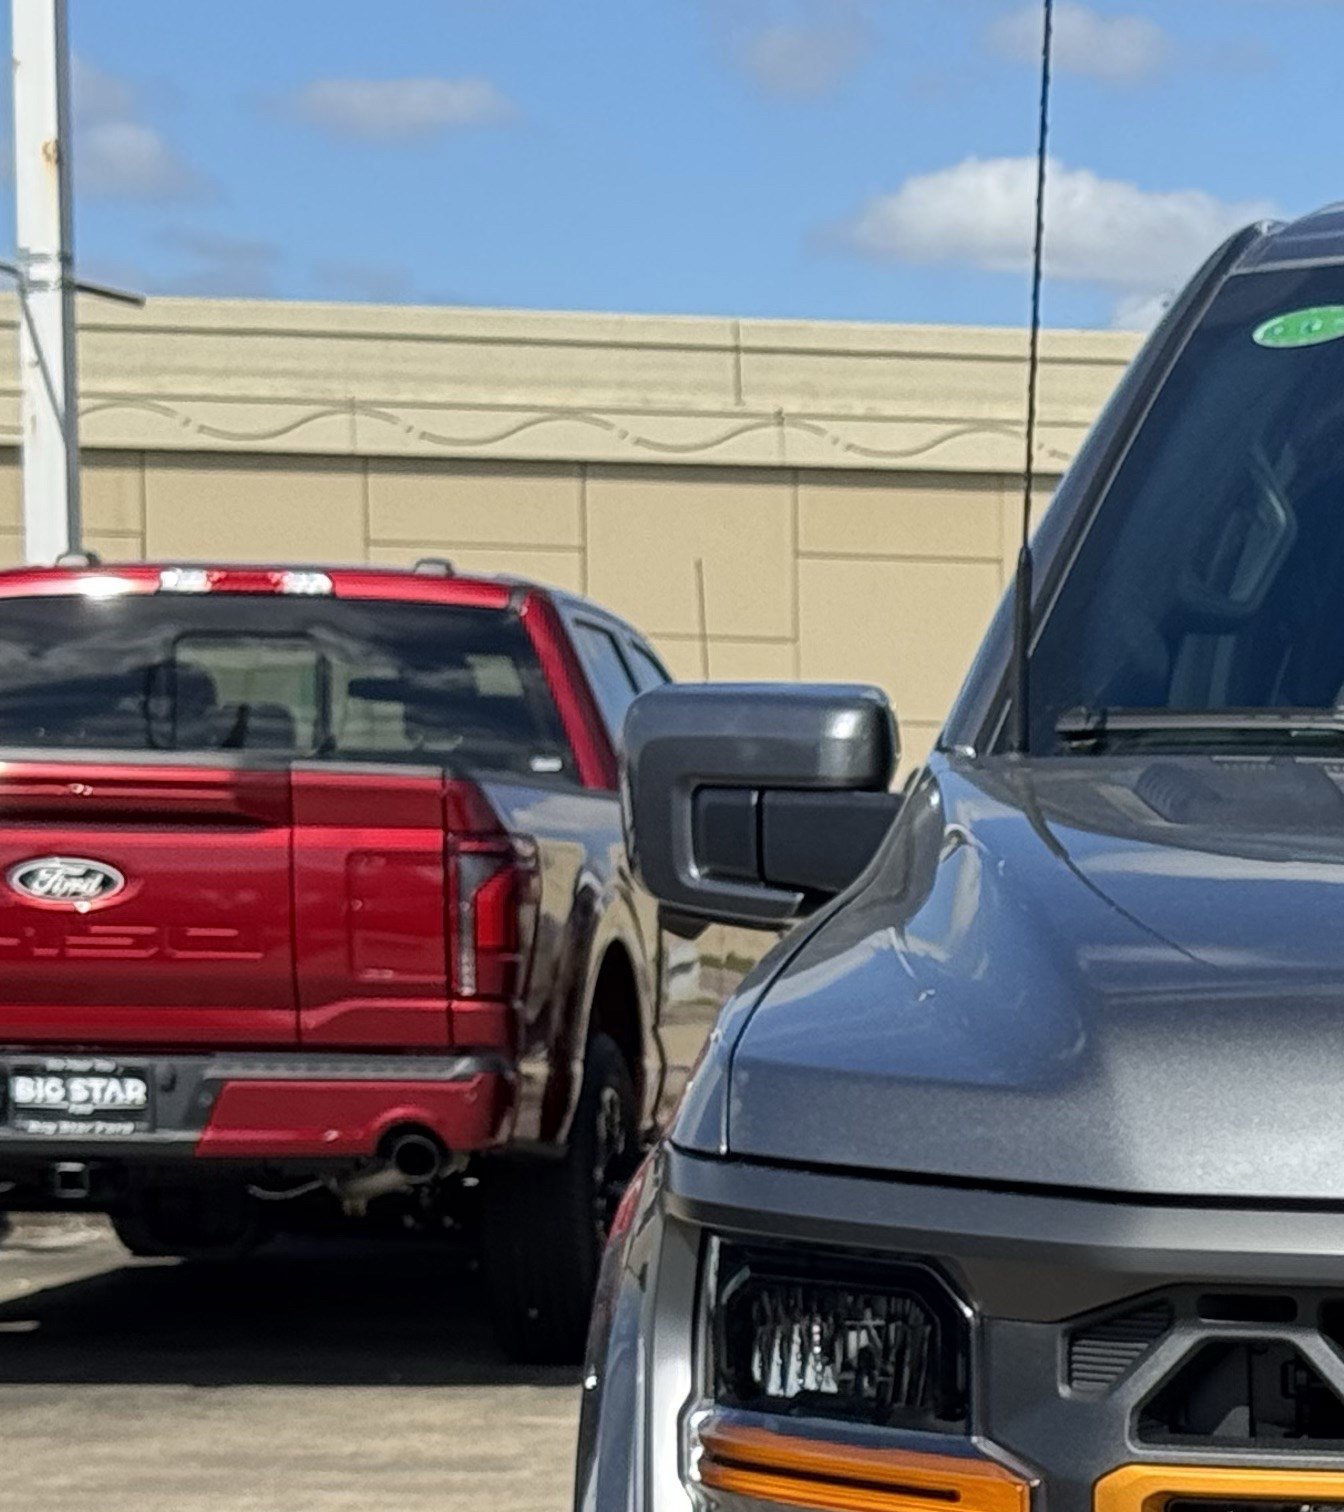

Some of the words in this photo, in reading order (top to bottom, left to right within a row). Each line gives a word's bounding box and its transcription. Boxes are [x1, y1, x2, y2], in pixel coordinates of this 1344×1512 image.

[31, 865, 105, 897] Ford
[13, 1076, 66, 1103] BIG
[68, 1077, 147, 1105] STAR
